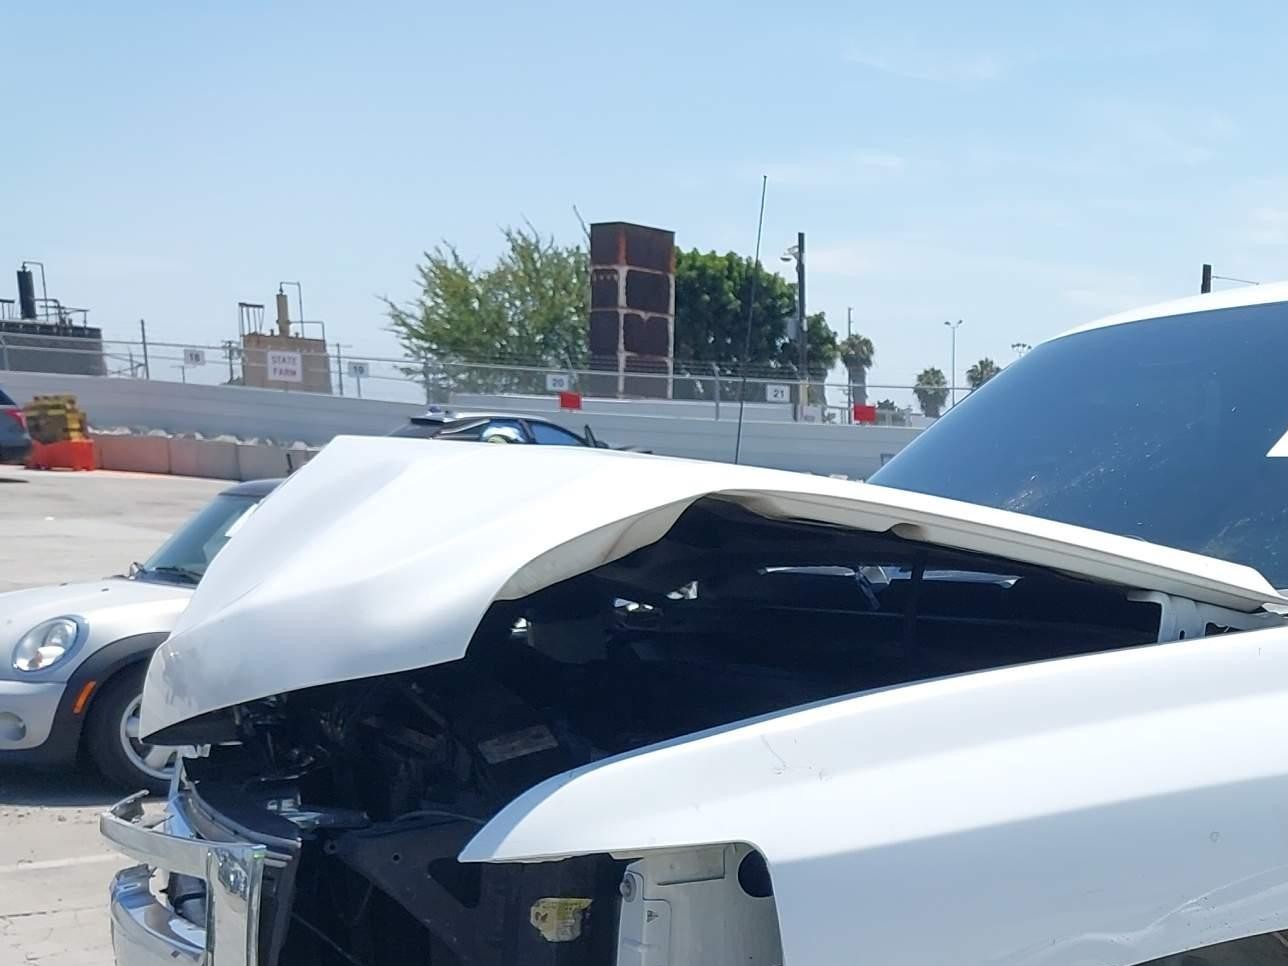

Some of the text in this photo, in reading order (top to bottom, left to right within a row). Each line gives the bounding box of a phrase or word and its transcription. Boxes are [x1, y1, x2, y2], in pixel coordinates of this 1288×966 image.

[271, 356, 297, 366] STATE
[273, 367, 297, 377] FARM
[553, 378, 565, 388] 20
[774, 388, 785, 399] 21
